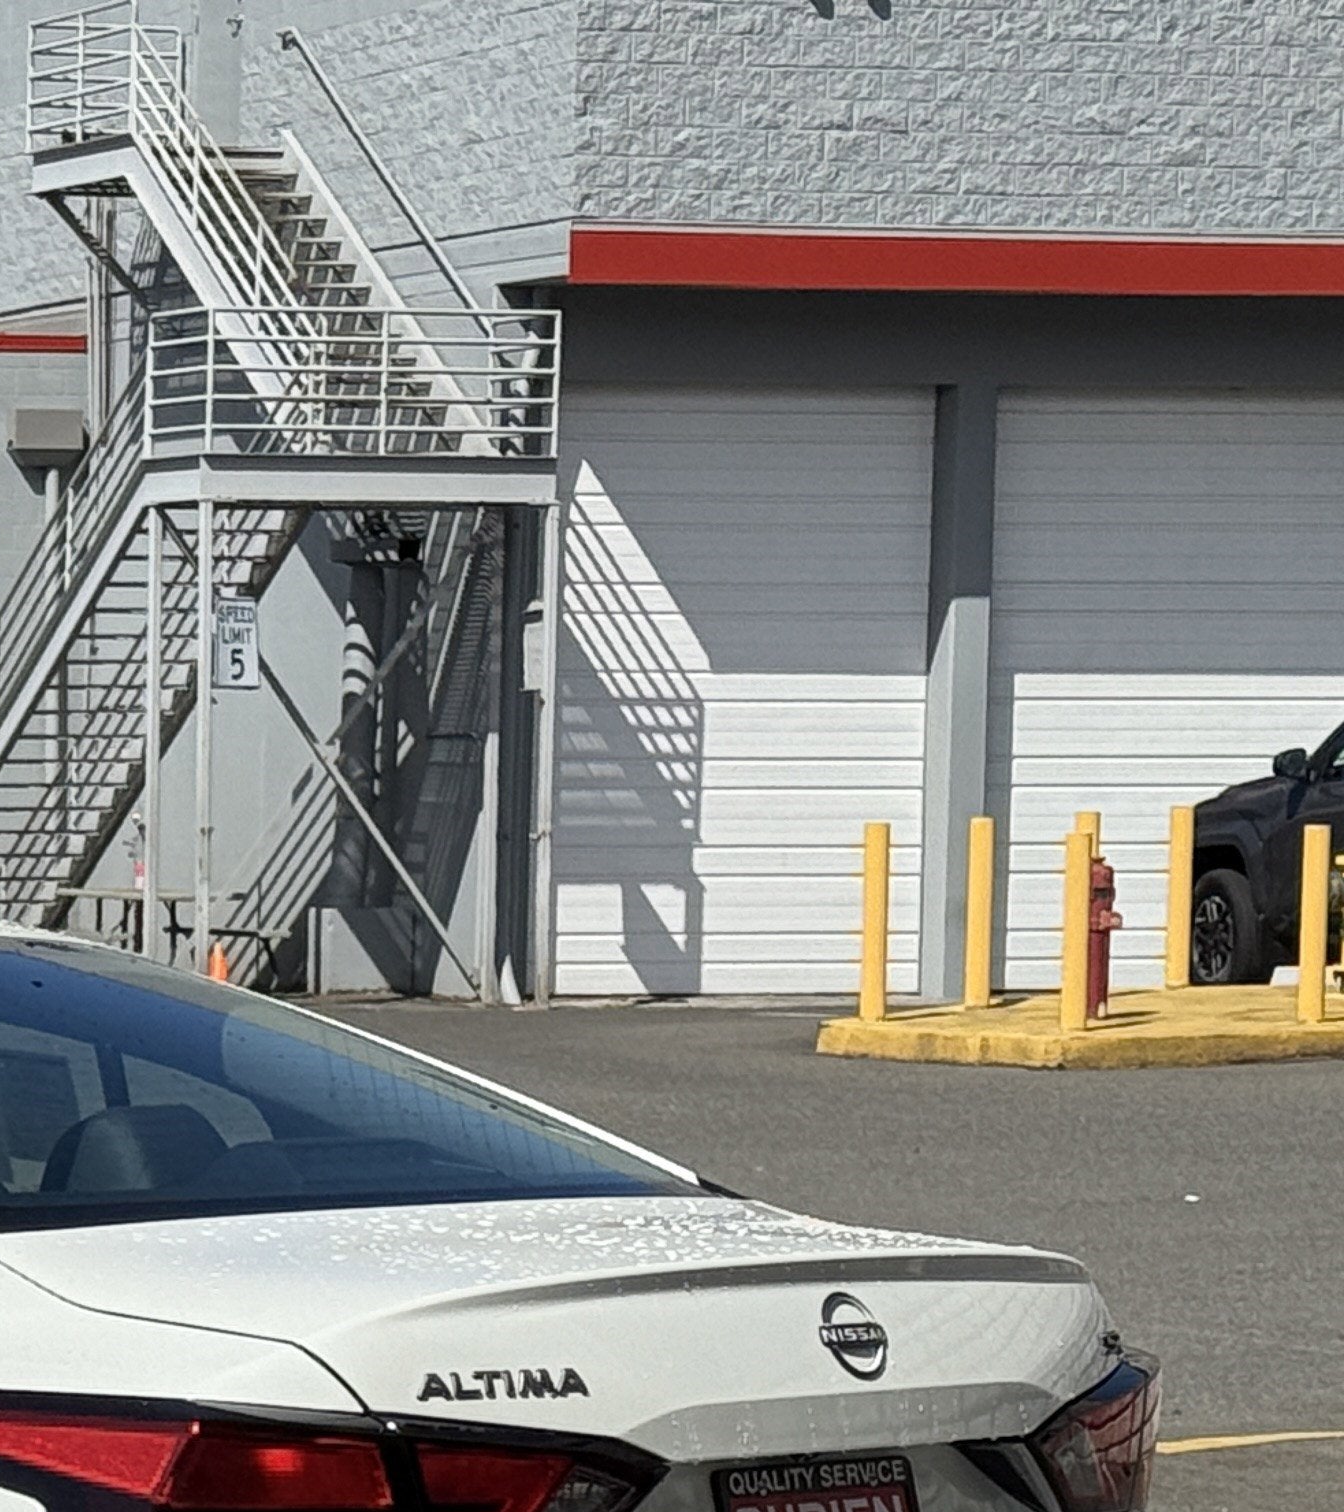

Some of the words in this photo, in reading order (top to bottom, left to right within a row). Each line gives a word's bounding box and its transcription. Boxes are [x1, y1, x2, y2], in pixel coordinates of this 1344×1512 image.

[217, 605, 255, 623] SPEED
[221, 626, 253, 645] LIMIT
[230, 648, 245, 681] 5
[416, 1367, 591, 1402] ALTIMA
[728, 1466, 815, 1496] QUALITY
[820, 1459, 907, 1488] SERVICE
